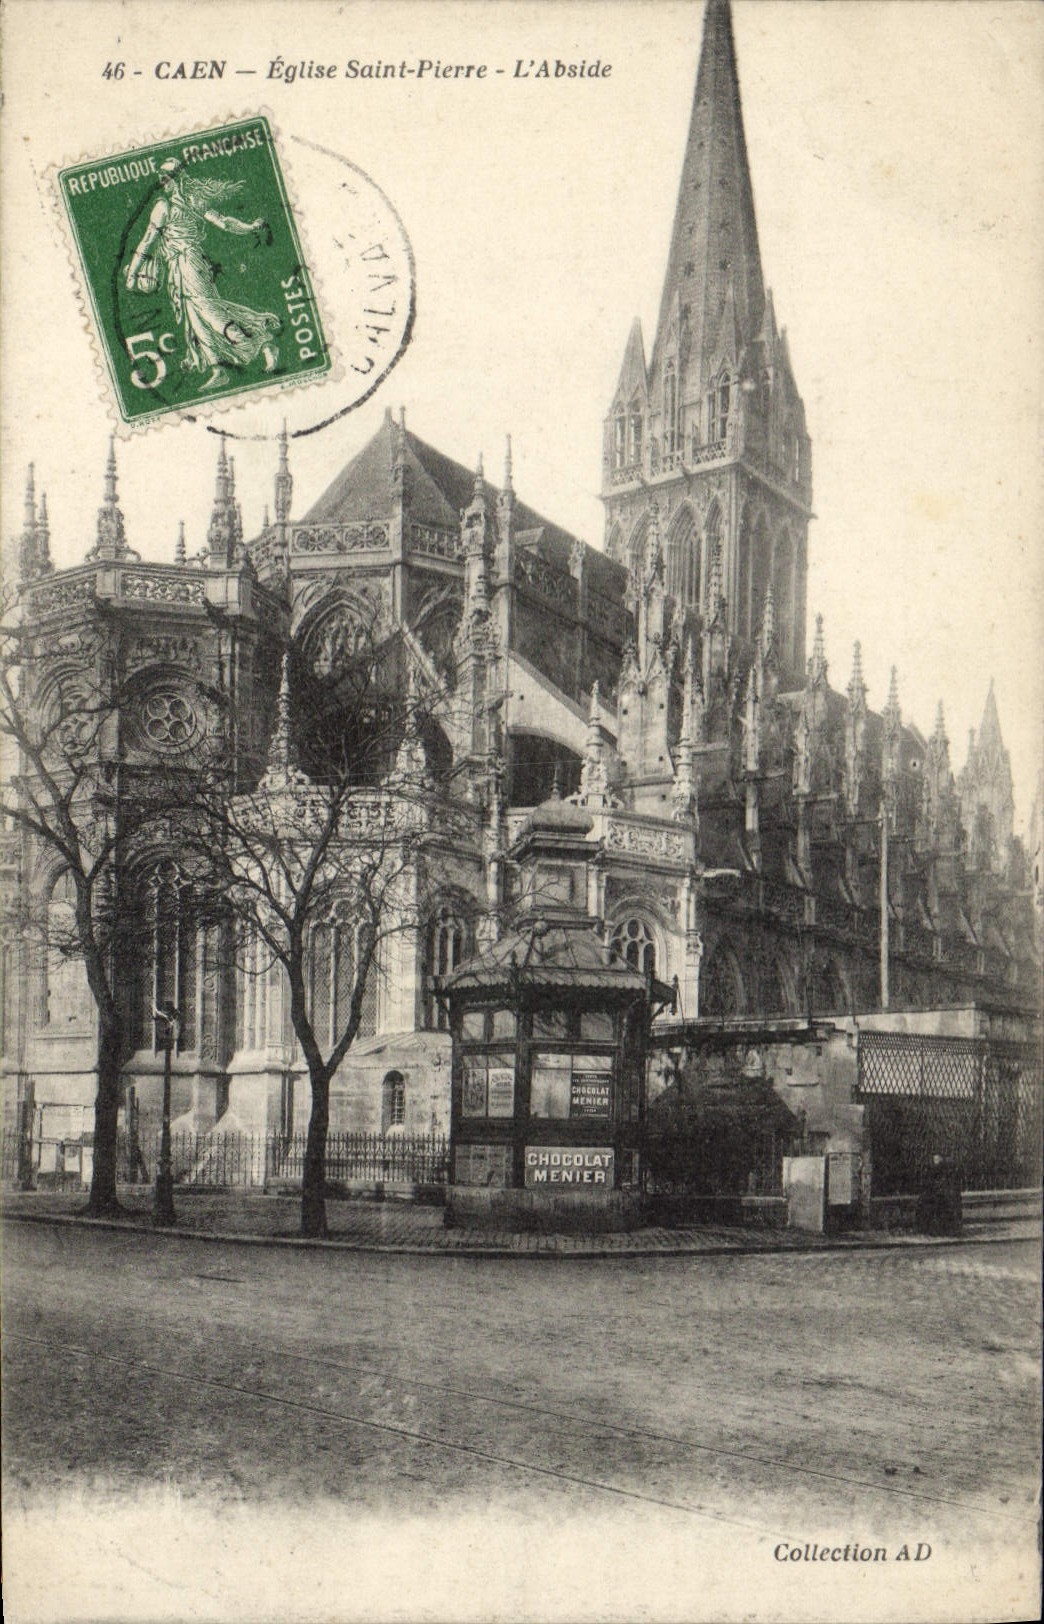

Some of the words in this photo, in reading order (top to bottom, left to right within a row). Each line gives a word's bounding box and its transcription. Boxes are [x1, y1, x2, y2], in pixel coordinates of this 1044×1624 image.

[182, 129, 264, 165] FRANÇAISE
[281, 275, 315, 360] POSTES
[572, 1086, 610, 1095] CHOCOLAT
[572, 1096, 609, 1106] MENIER
[527, 1153, 612, 1167] CHOCOLAT
[534, 1170, 606, 1183] MENIER
